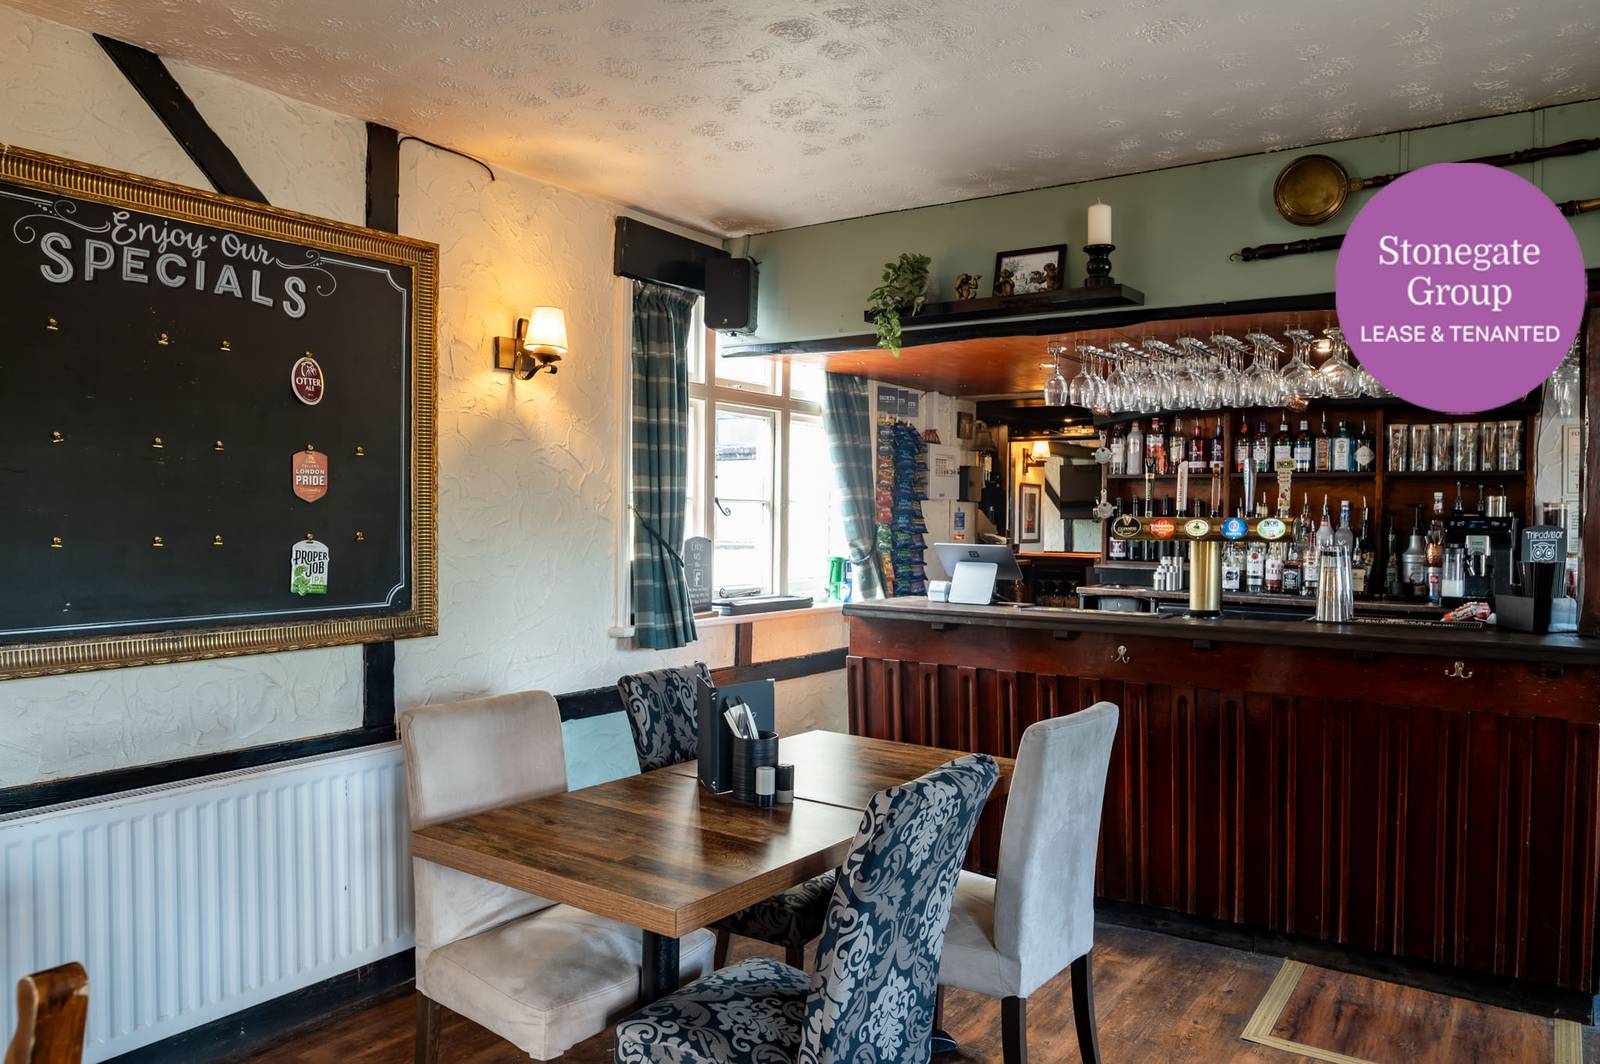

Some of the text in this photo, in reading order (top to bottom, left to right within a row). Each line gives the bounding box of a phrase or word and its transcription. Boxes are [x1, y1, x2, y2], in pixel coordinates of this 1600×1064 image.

[111, 211, 275, 265] Enjoy Our
[40, 231, 308, 319] SPECIALS
[295, 377, 321, 386] OTTER
[295, 475, 325, 486] PRIDE
[293, 550, 328, 565] PROPER
[305, 561, 325, 577] JOB
[312, 576, 326, 585] IPA
